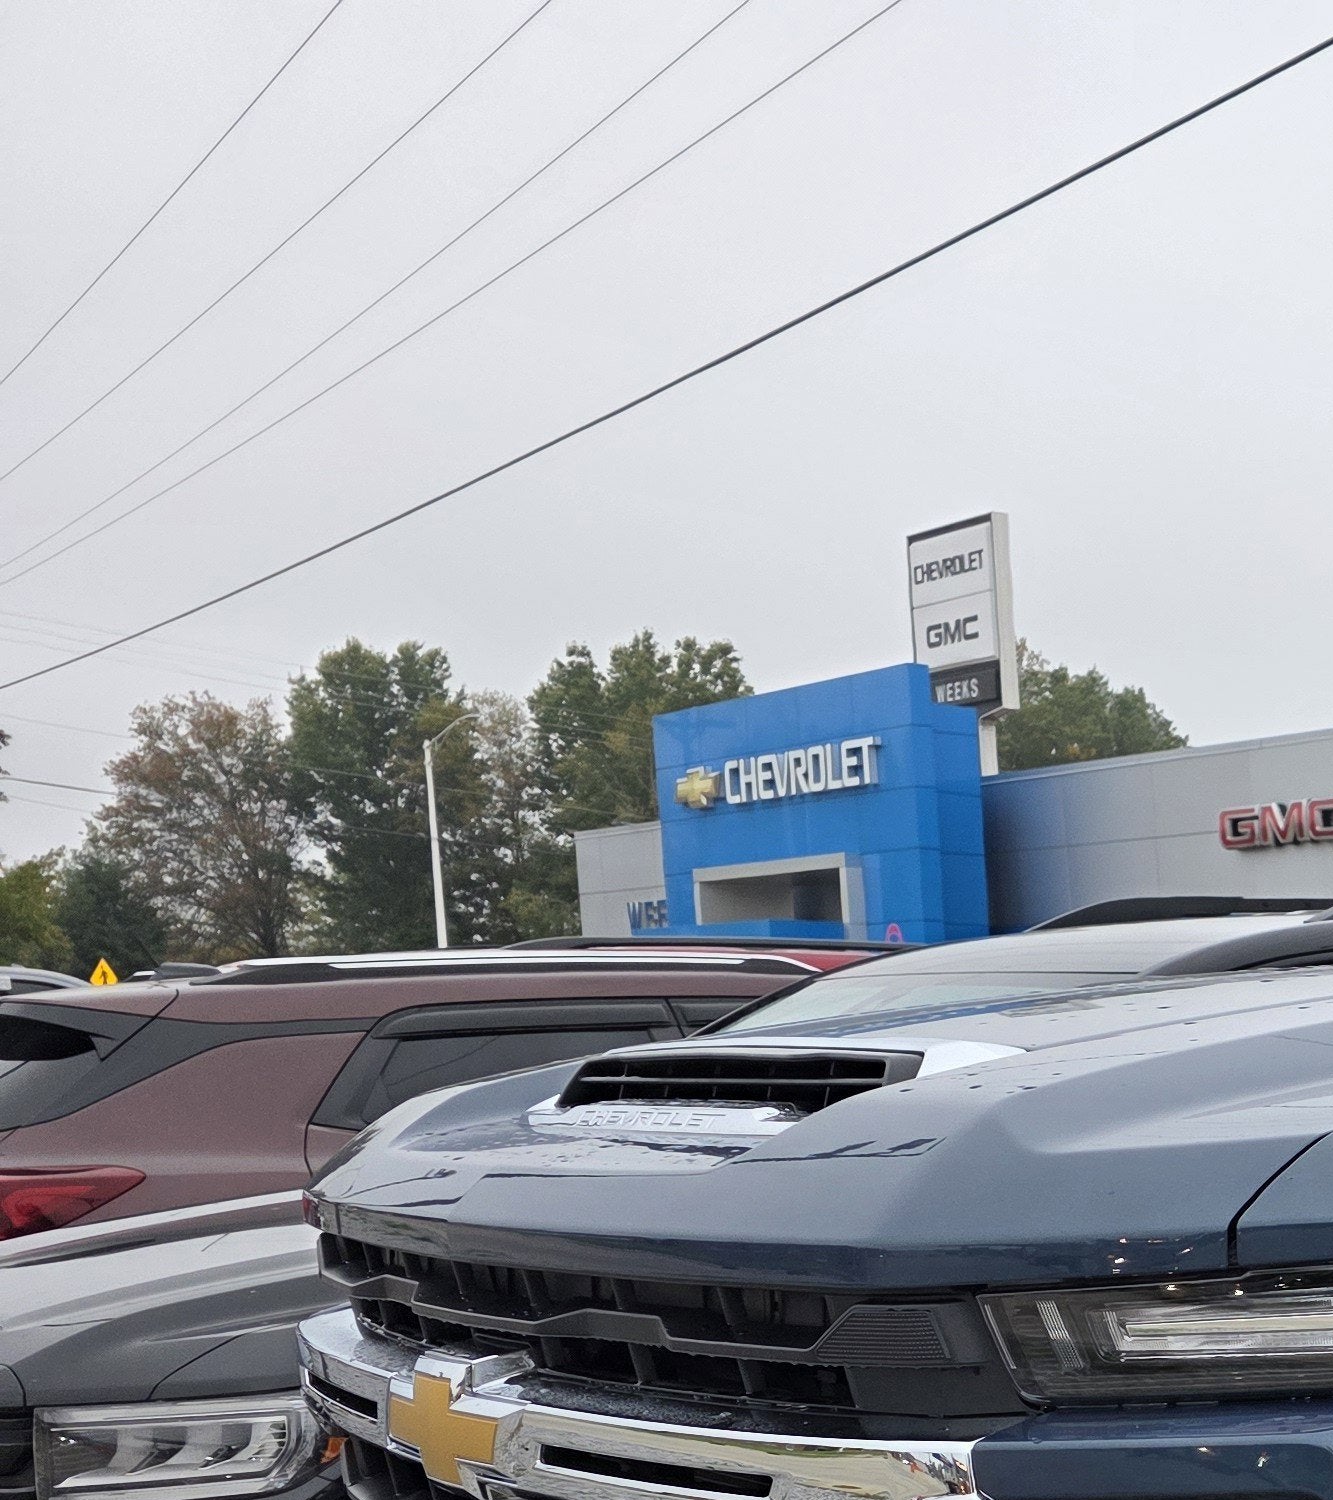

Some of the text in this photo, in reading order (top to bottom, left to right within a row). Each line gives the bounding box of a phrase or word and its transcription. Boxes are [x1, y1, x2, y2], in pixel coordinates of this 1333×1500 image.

[913, 549, 984, 585] CHEVROLET
[926, 614, 980, 649] GMC
[935, 678, 979, 703] WEEKS
[724, 736, 881, 804] CHEVROLET
[573, 1109, 727, 1128] CHEVROLET
